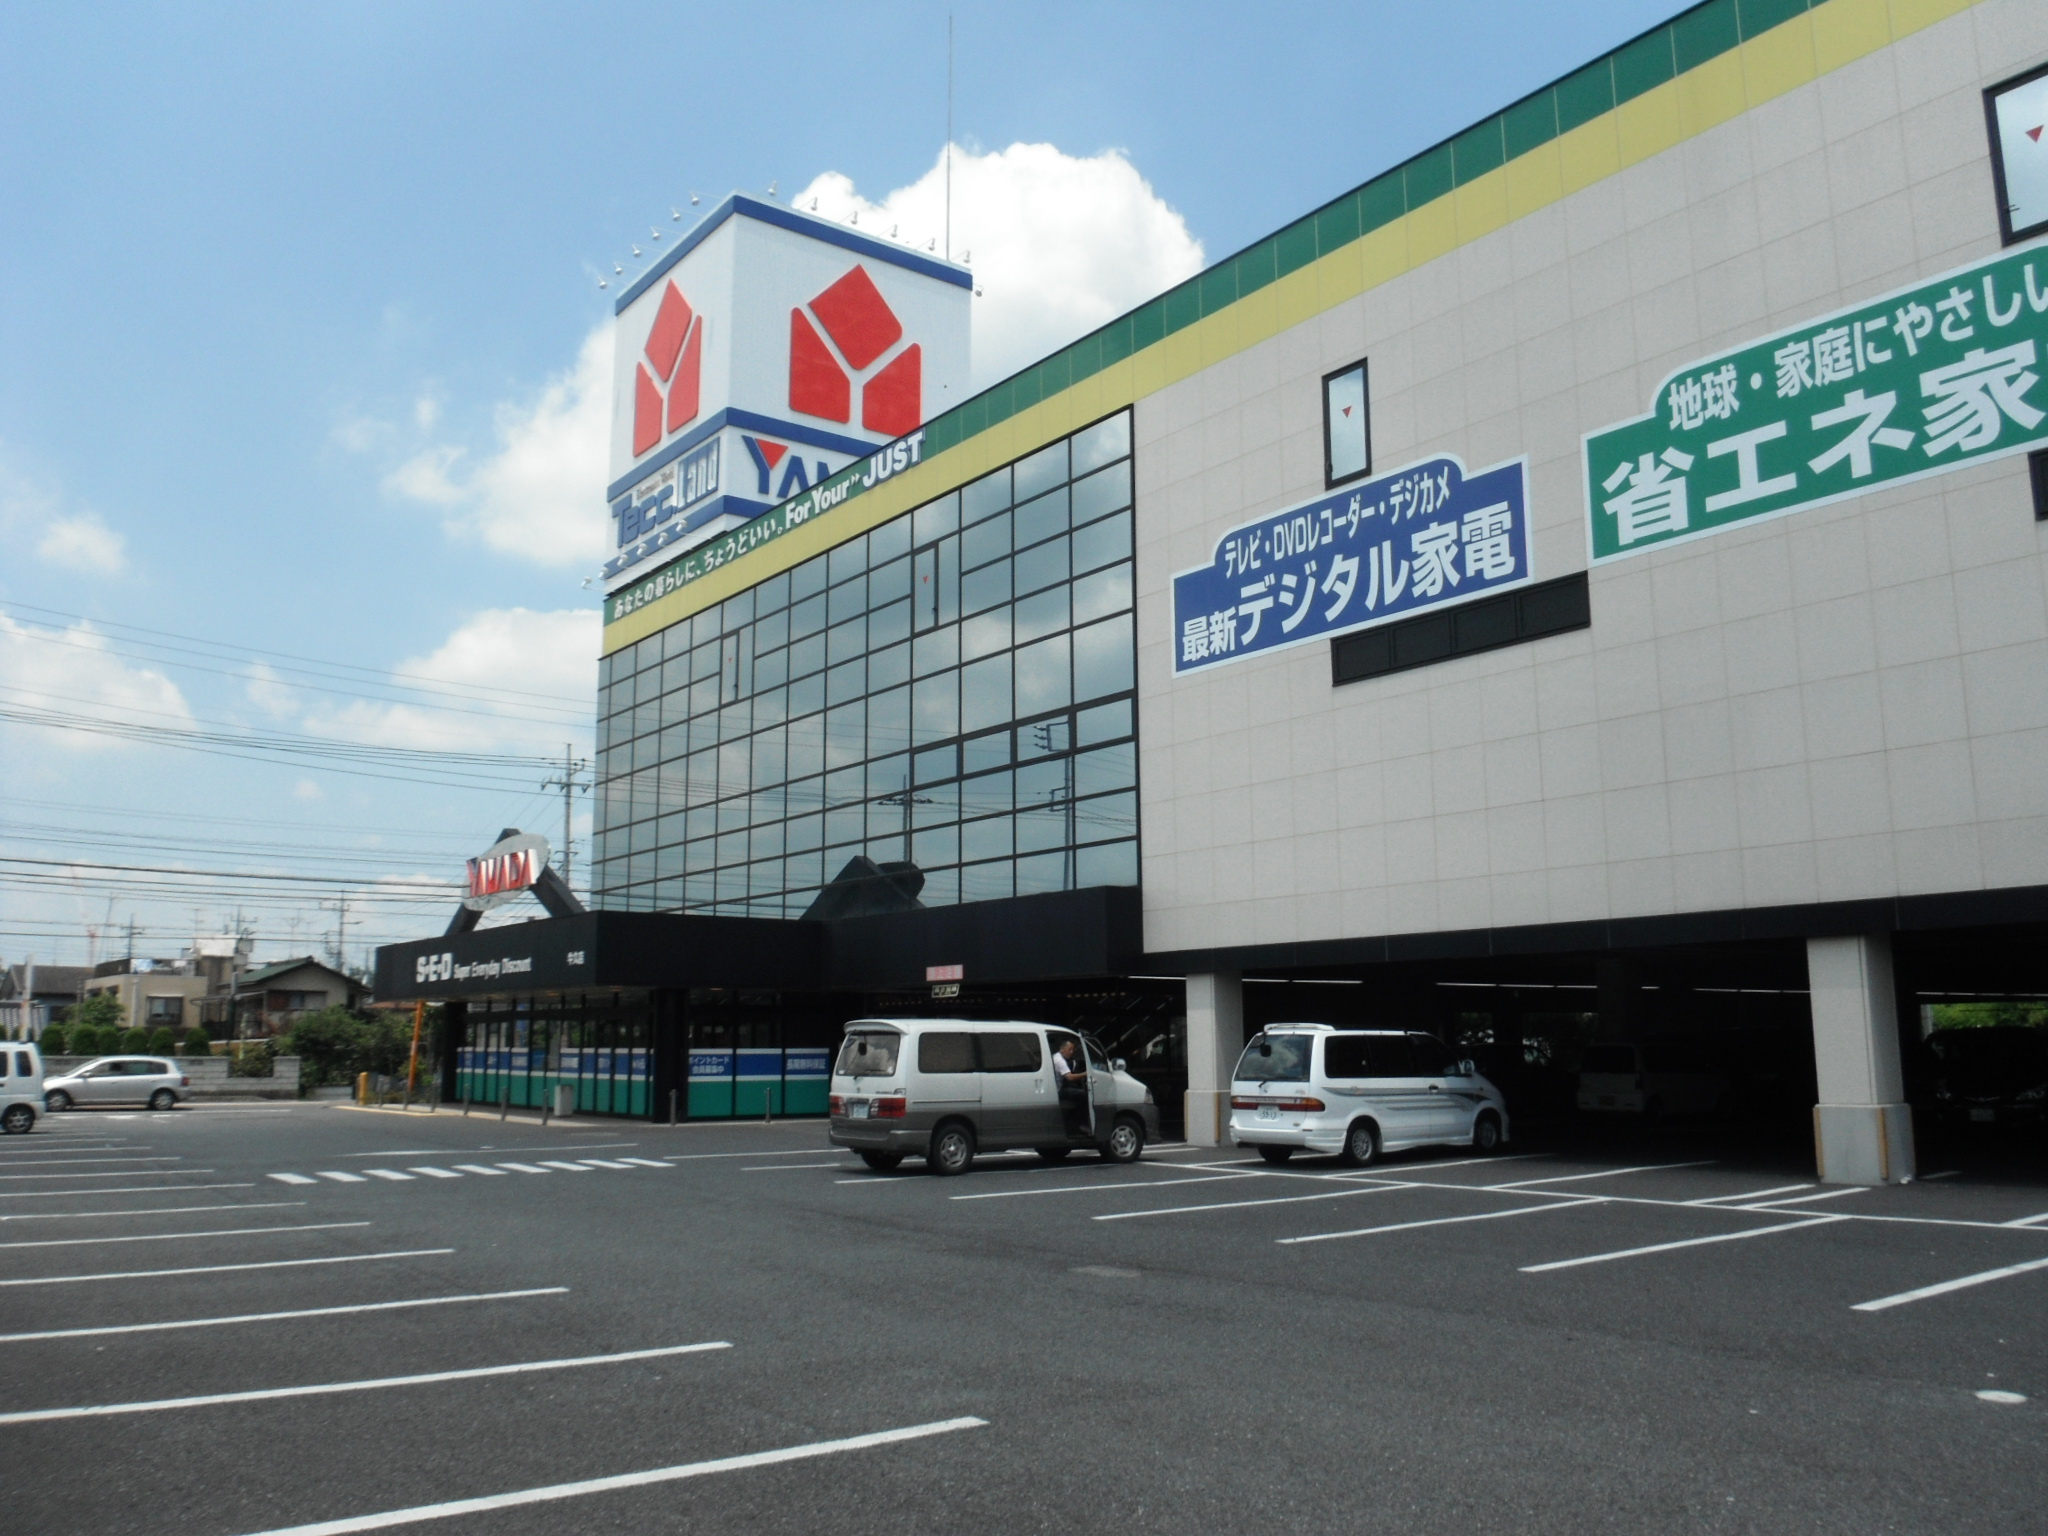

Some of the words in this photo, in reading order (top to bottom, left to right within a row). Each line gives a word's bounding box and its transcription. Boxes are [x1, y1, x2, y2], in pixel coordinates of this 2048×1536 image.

[785, 500, 812, 529] For
[811, 479, 850, 515] Your
[1602, 339, 2048, 546] 省エネ家
[1182, 501, 1515, 662] 最新デジタル家電
